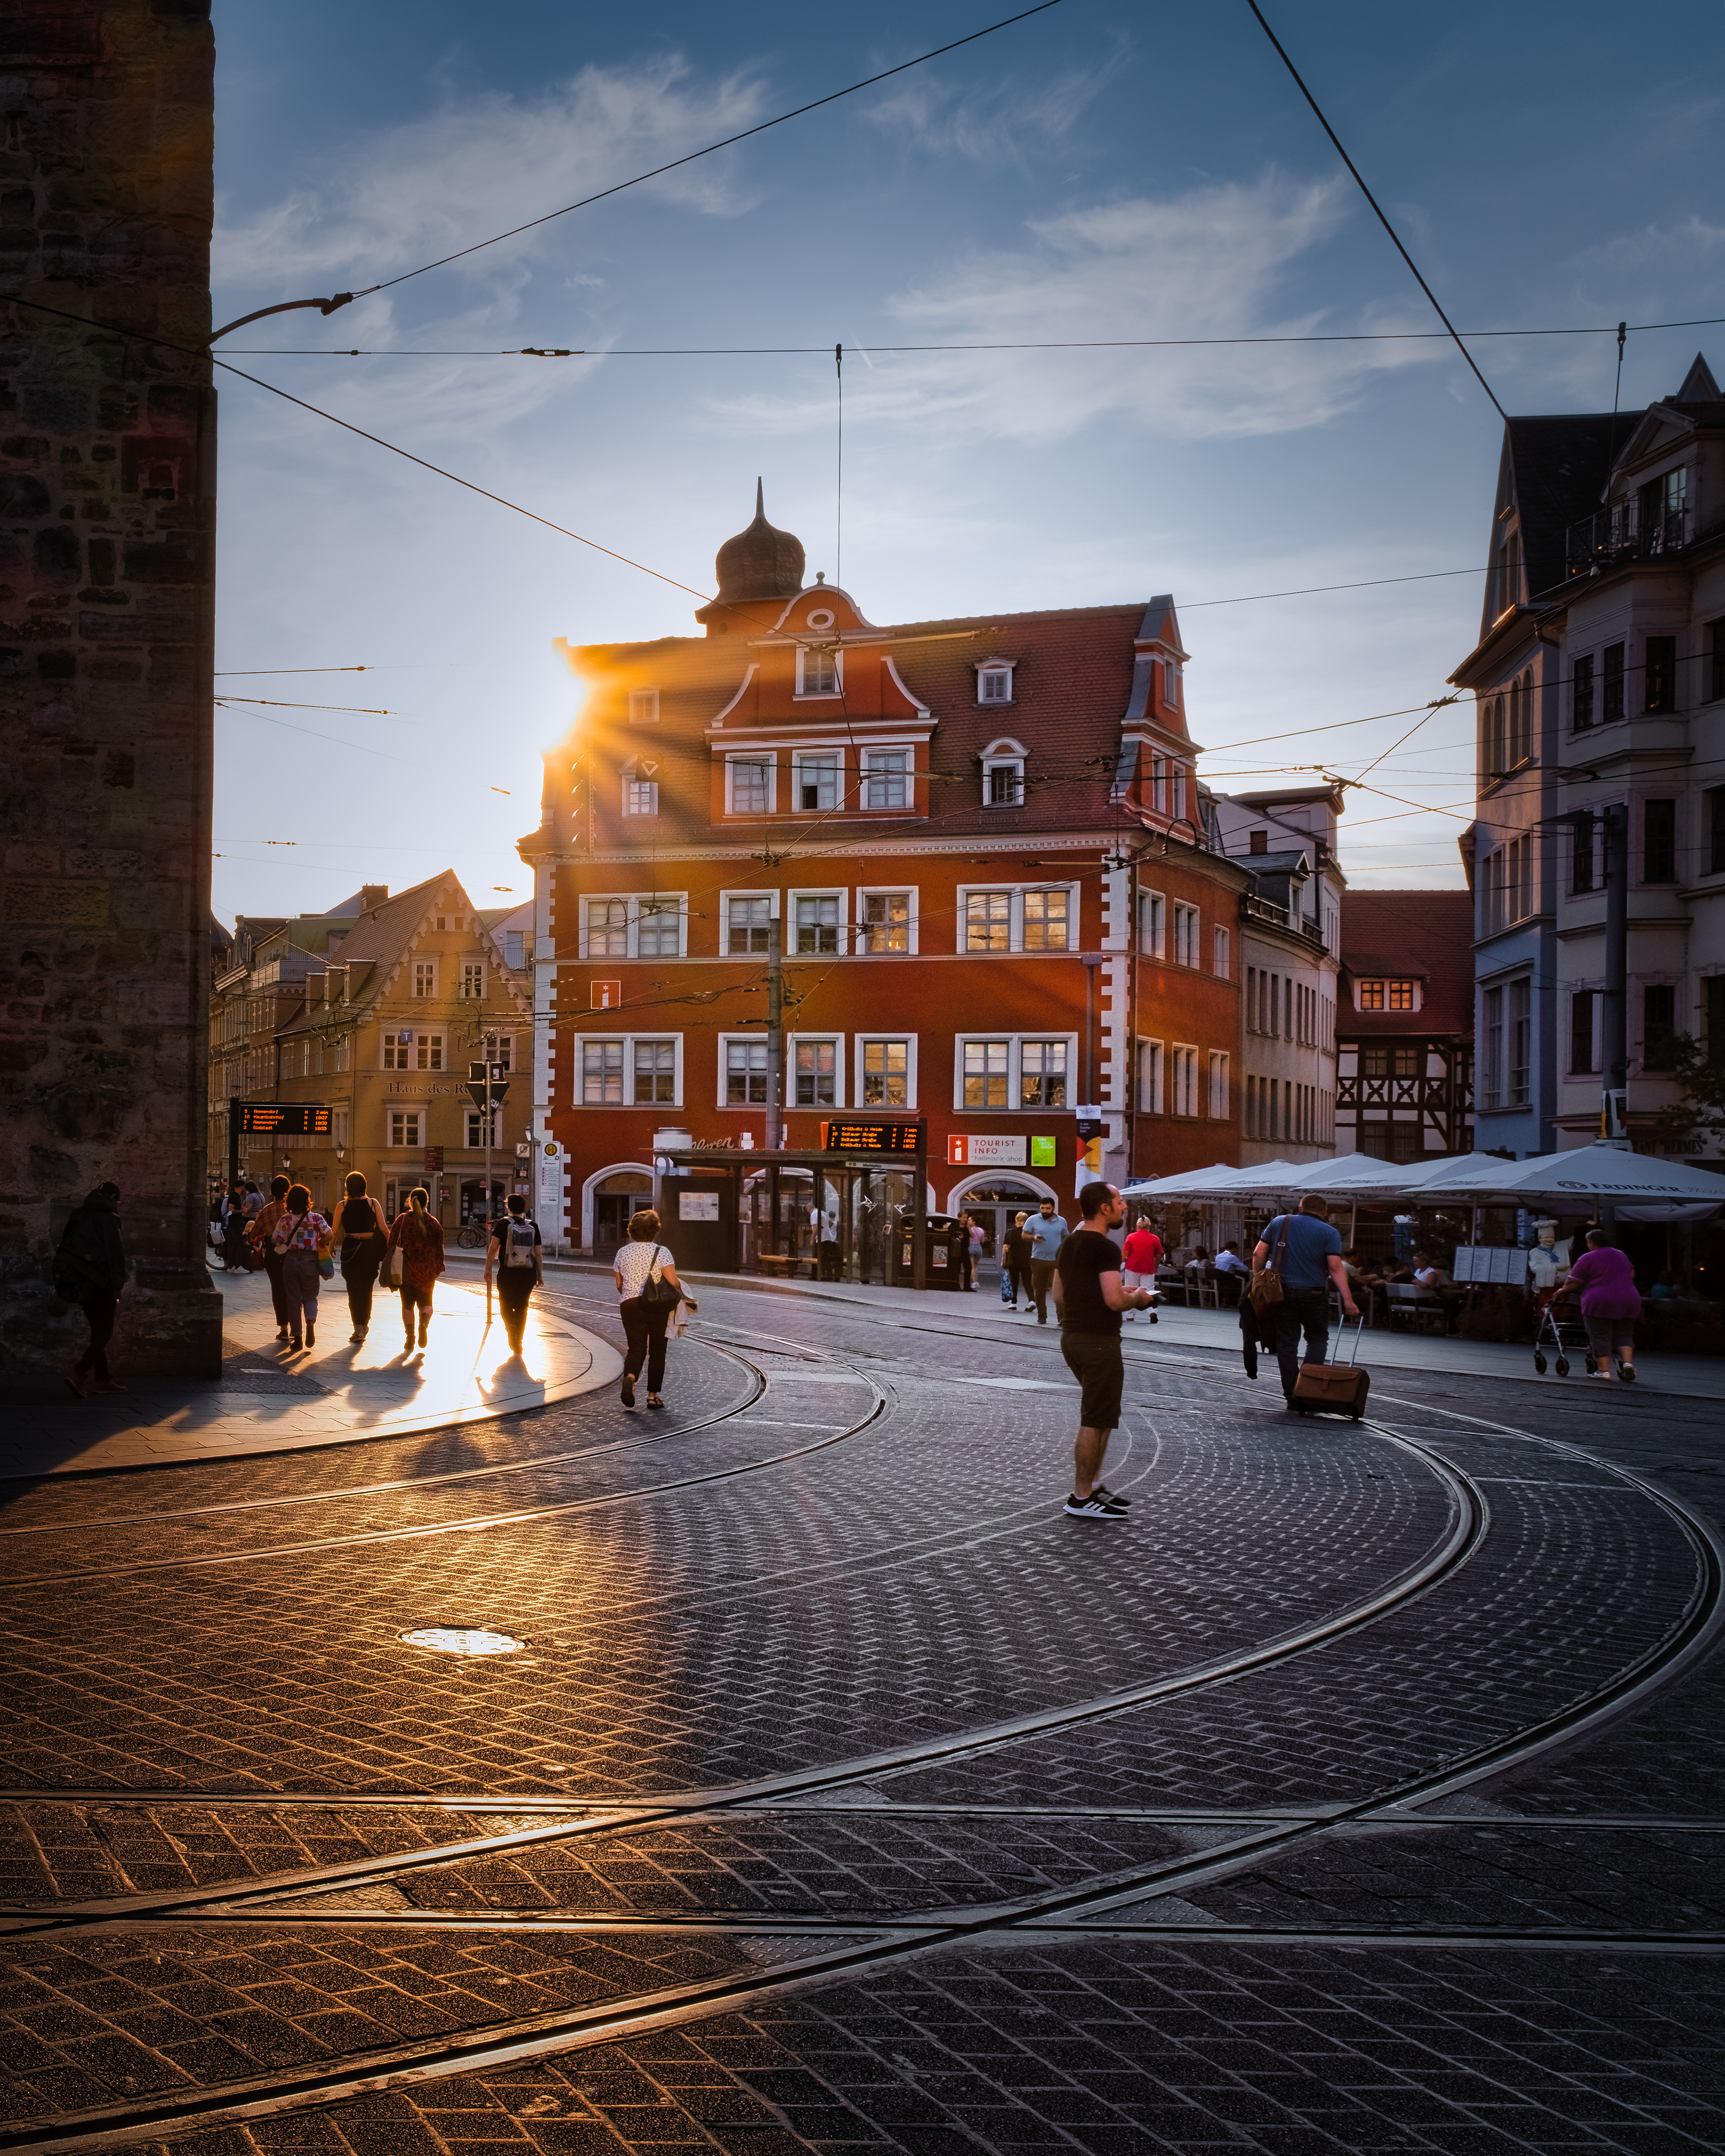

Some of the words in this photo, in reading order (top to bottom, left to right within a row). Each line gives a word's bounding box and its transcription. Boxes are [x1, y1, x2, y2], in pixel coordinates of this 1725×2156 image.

[403, 1032, 410, 1040] T
[388, 1082, 424, 1093] Haus
[428, 1082, 450, 1093] des
[1589, 1183, 1686, 1193] ERDINGER
